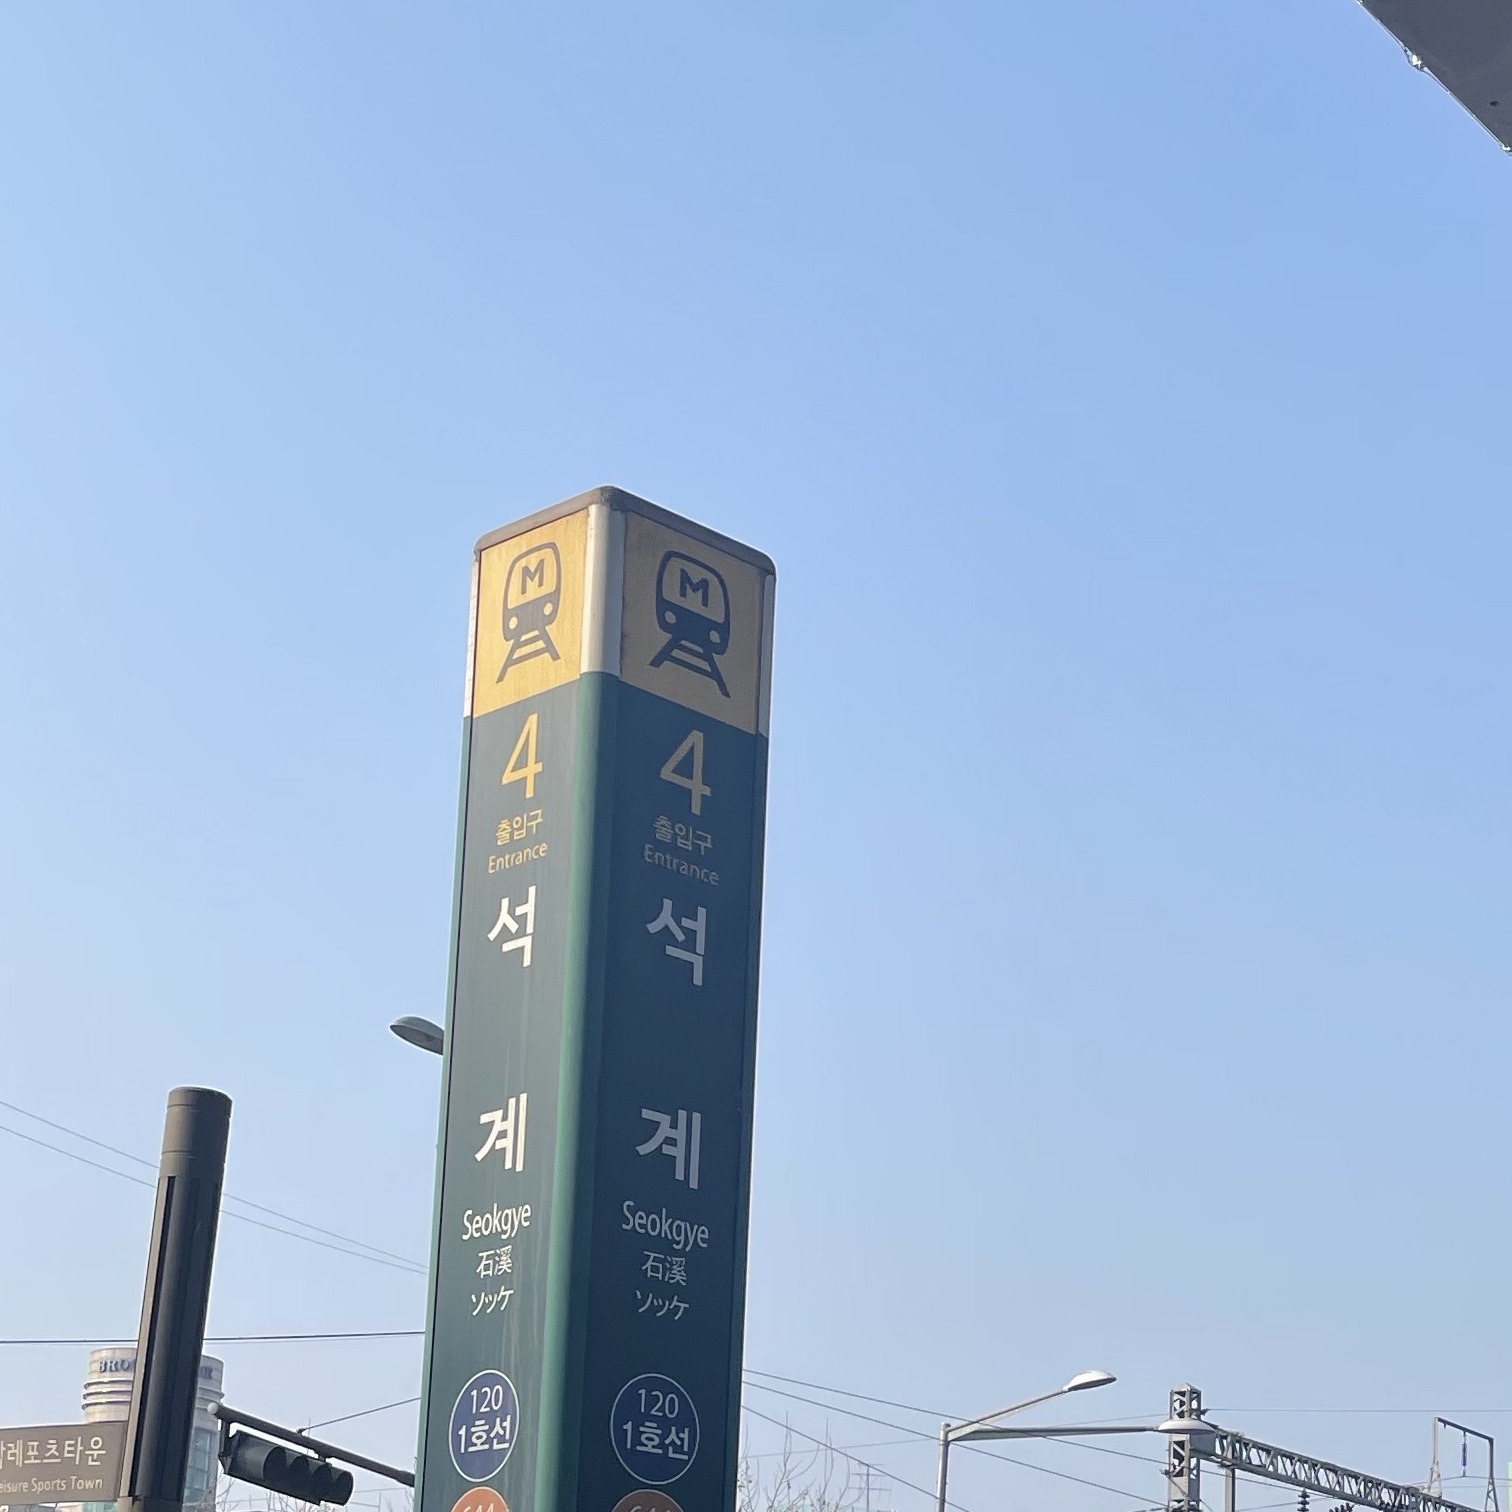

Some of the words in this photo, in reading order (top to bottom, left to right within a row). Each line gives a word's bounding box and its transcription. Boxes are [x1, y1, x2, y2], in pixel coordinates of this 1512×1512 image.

[520, 558, 545, 595] M
[678, 568, 710, 608] M
[501, 713, 543, 799] 4
[659, 729, 712, 816] 4
[495, 810, 544, 846] 출입구
[652, 815, 714, 857] 출입구
[488, 840, 548, 875] Entrance
[643, 845, 720, 886] Entrance
[462, 1202, 532, 1241] Seokgye
[621, 1200, 710, 1252] Seokgye
[475, 1245, 513, 1279] 石溪
[640, 1250, 688, 1287] 石溪
[470, 1384, 504, 1414] 120
[637, 1388, 680, 1419] 120
[458, 1414, 512, 1454] 1호선
[622, 1420, 690, 1461] 1호선
[31, 1476, 67, 1495] Sports
[70, 1476, 103, 1490] Town
